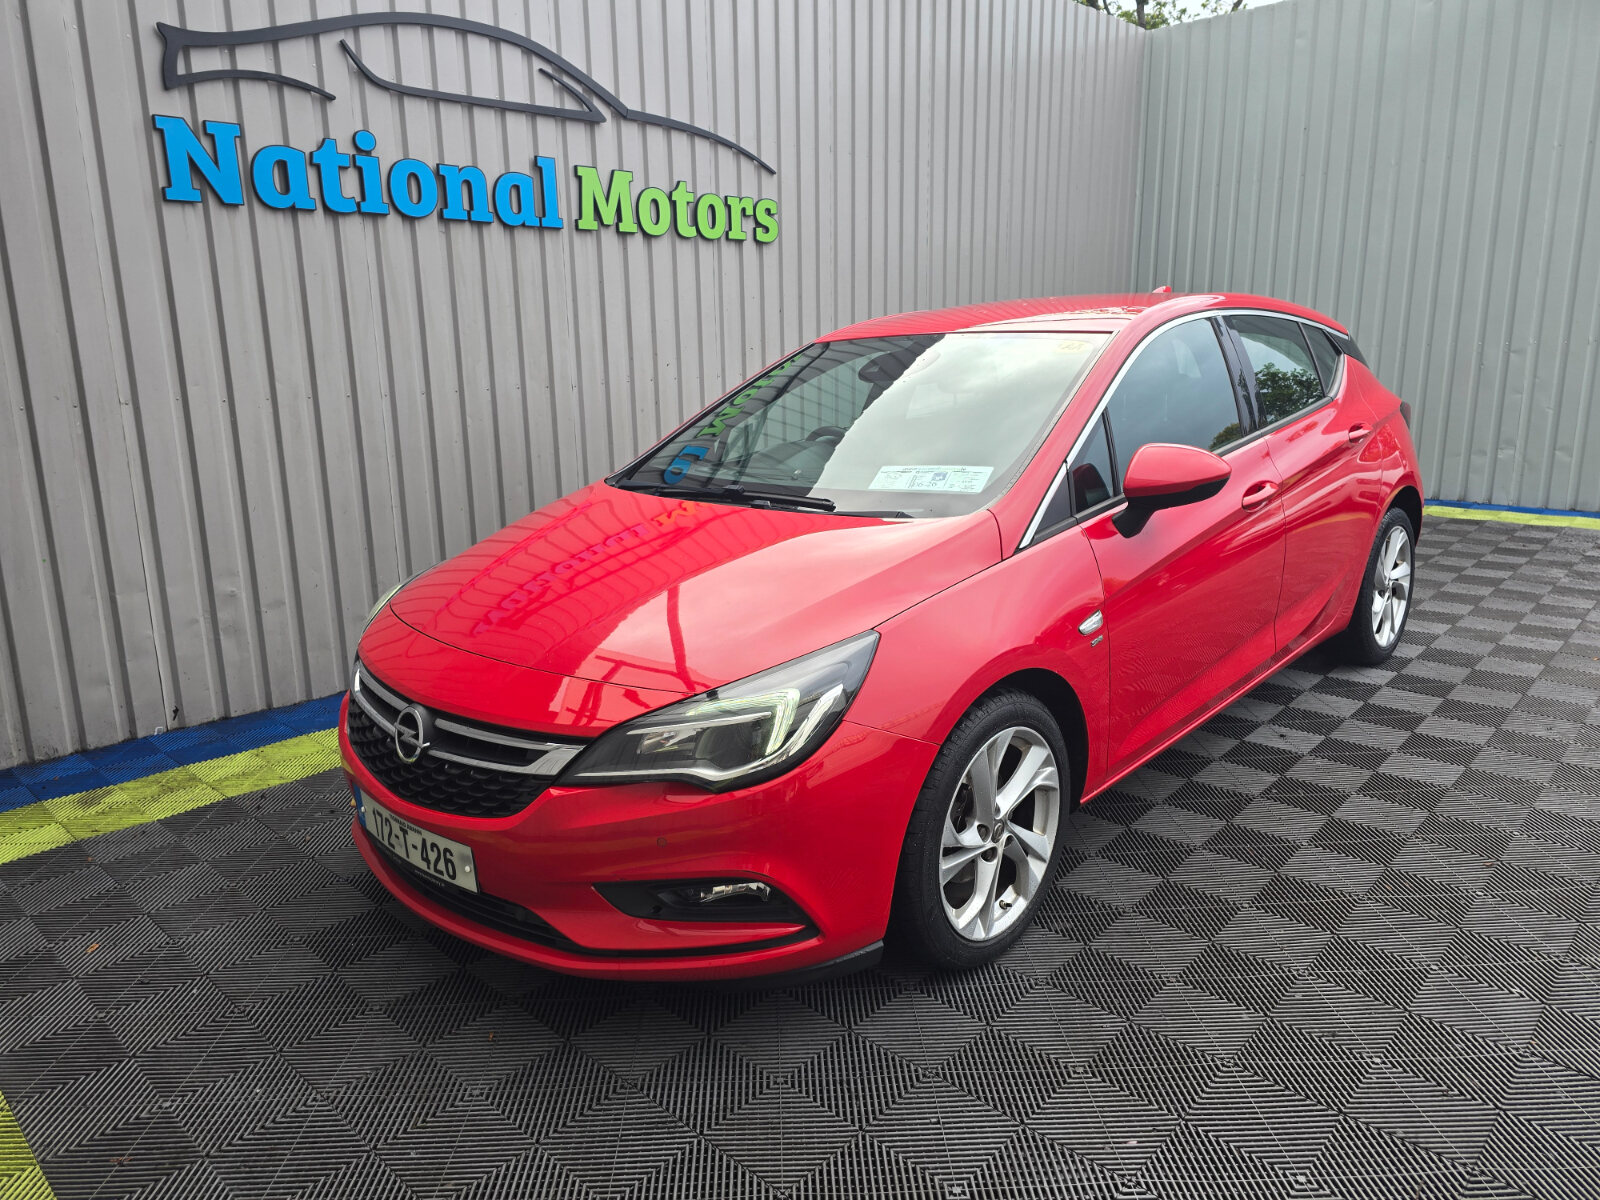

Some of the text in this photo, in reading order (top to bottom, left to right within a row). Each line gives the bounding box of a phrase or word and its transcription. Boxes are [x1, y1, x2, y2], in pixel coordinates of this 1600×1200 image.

[152, 114, 780, 244] National Motors
[372, 808, 457, 881] 172-T-426
